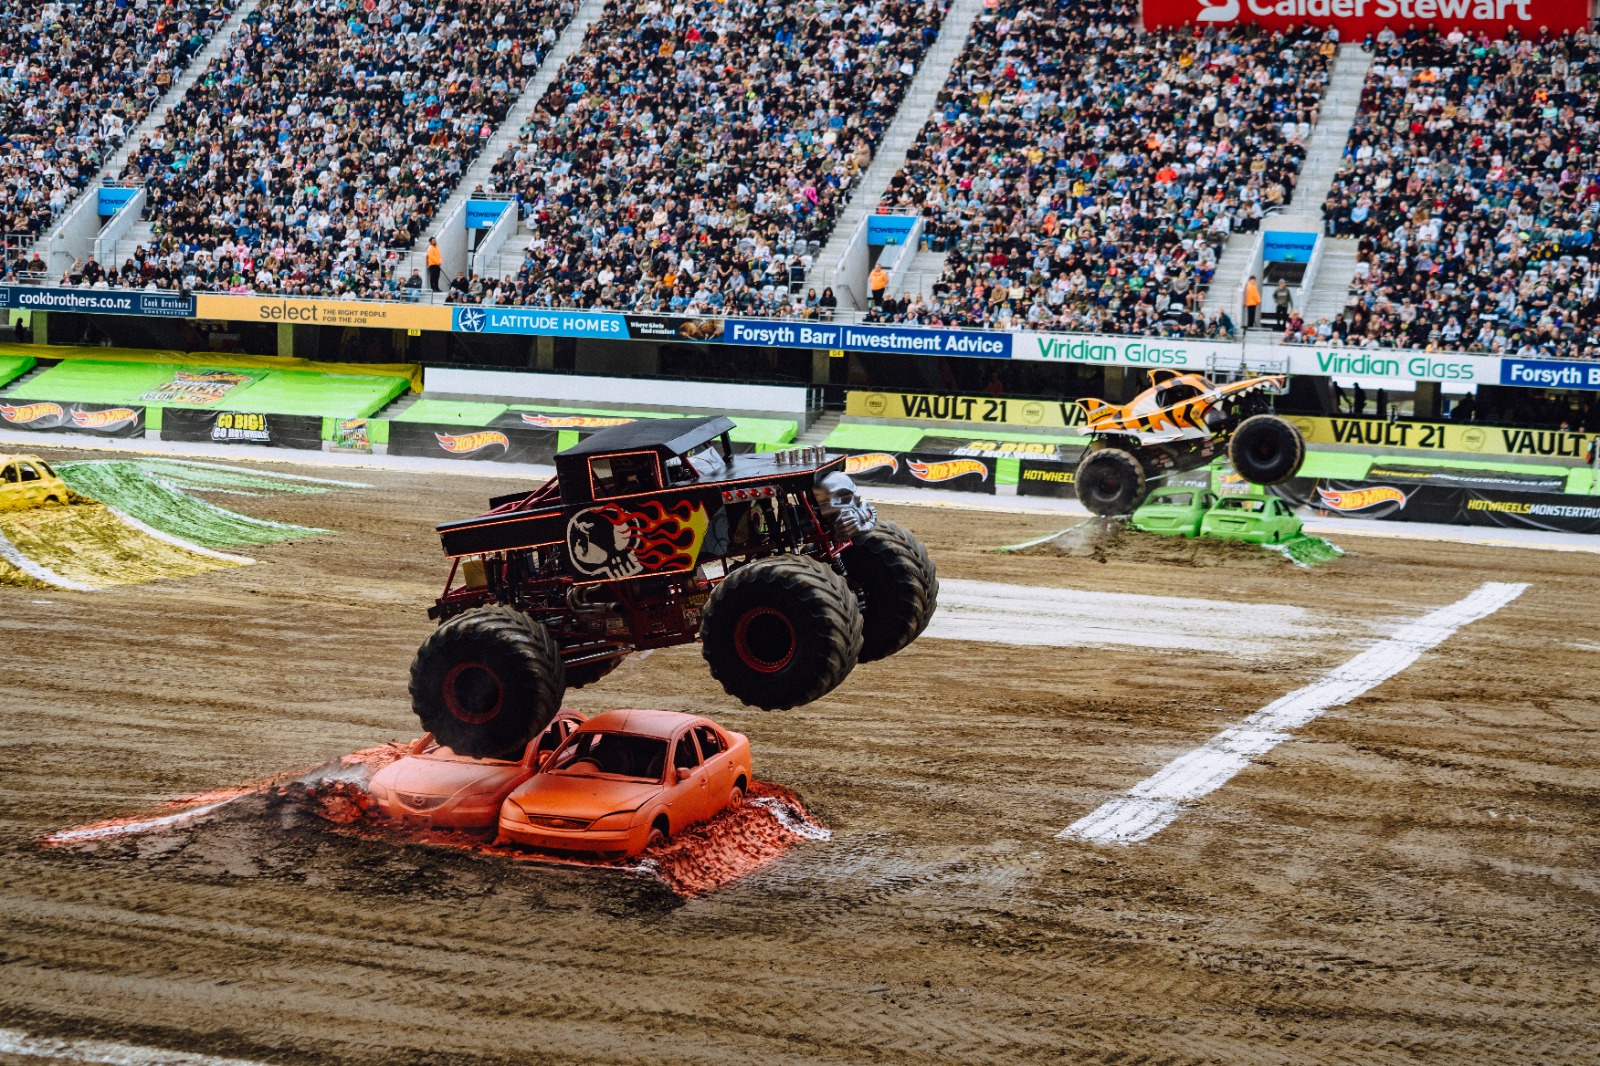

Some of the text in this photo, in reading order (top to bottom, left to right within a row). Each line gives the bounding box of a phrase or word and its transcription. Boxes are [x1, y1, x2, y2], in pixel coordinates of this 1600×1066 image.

[1248, 0, 1532, 21] Calder Stewart
[19, 292, 131, 309] cookbrothers.co.nz
[260, 301, 318, 321] select
[338, 309, 358, 317] RIGHT
[360, 310, 387, 318] PEOPLE
[491, 314, 620, 333] LATITUDE HOMES
[733, 324, 837, 345] Forsyth Barr
[846, 330, 1004, 353] Investment Advice
[1037, 337, 1188, 365] Viridian Glass
[1316, 351, 1474, 380] Viridian Glass
[1511, 364, 1582, 387] Forsyth
[901, 394, 1007, 423] VAULT 21
[213, 427, 227, 438] GO
[217, 413, 264, 431] GO BIG!
[1330, 419, 1445, 449] VAULT 21
[1502, 429, 1587, 457] VAULT
[1023, 470, 1076, 484] HOTWHEEL
